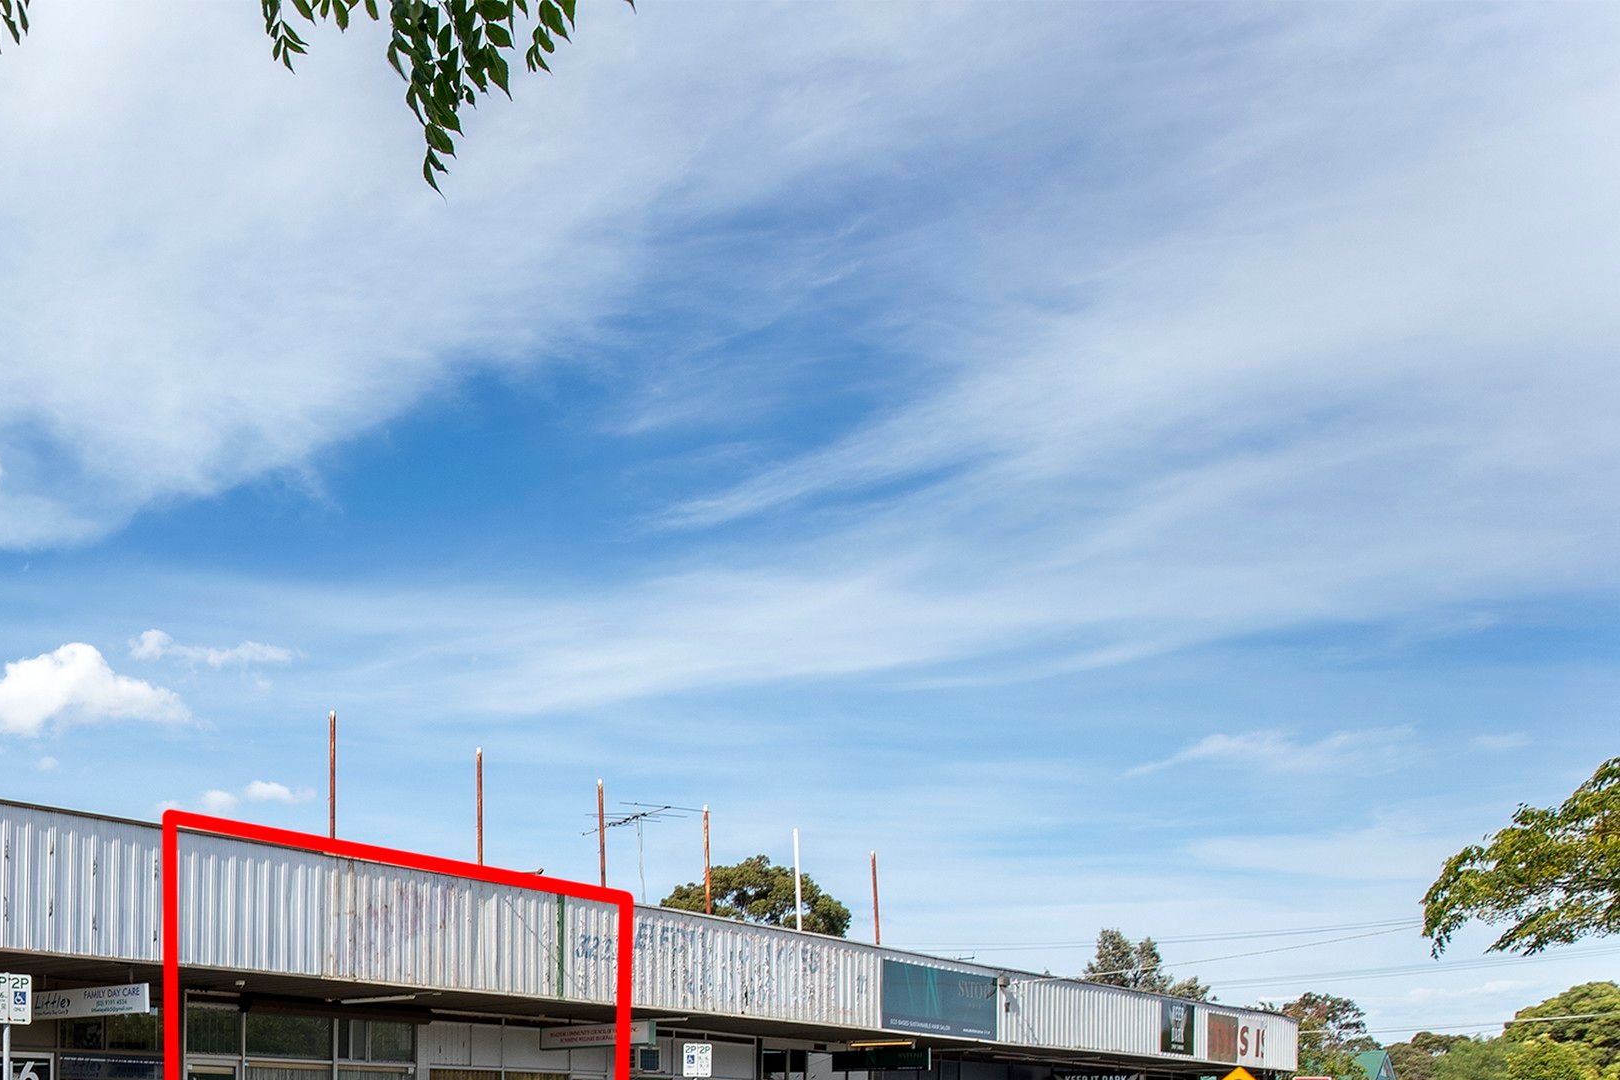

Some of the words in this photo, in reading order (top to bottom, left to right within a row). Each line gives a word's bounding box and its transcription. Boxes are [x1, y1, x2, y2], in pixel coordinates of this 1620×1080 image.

[12, 977, 29, 989] 2P
[83, 990, 108, 1000] FAMILY
[108, 988, 122, 998] DAY
[123, 987, 140, 997] CARE
[686, 1045, 697, 1054] 2P
[700, 1046, 711, 1054] 2P
